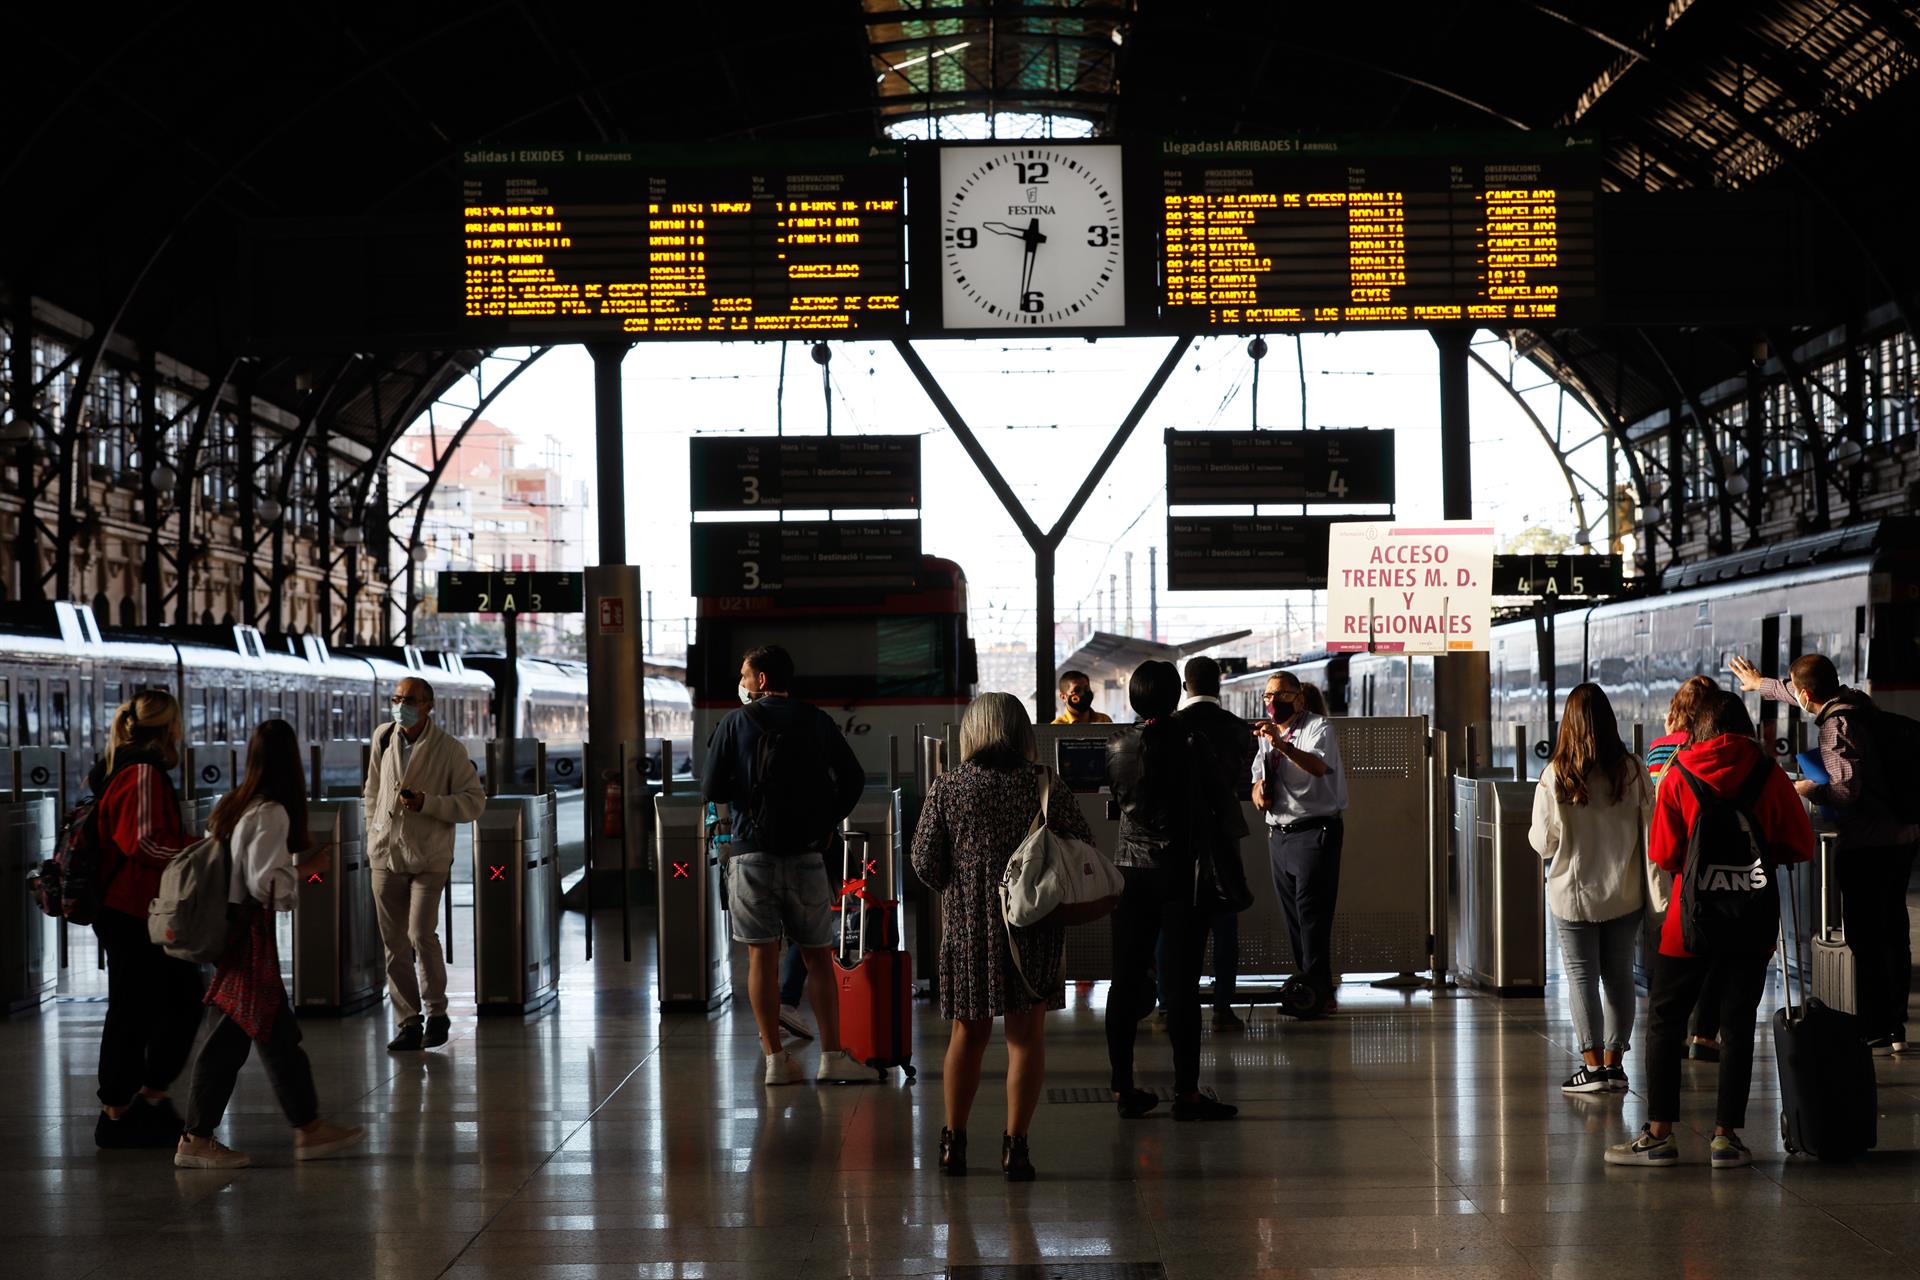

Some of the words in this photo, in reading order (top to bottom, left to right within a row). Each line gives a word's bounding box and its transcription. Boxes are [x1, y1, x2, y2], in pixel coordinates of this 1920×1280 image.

[464, 151, 508, 162] Salidas
[519, 149, 565, 162] EIXIDES
[1163, 140, 1221, 155] Llegadas
[1226, 138, 1291, 152] ARRIBADES
[1013, 162, 1049, 184] 12
[1008, 205, 1056, 216] FESTINA
[957, 227, 978, 249] 9
[1087, 225, 1109, 247] 3
[1024, 292, 1044, 313] 6
[742, 476, 760, 504] 3
[1327, 470, 1348, 498] 4
[1370, 545, 1449, 564] ACCESO
[742, 561, 760, 590] 3
[1342, 568, 1417, 587] TRENES
[1424, 568, 1448, 587] M.
[1456, 568, 1477, 587] D.
[1517, 576, 1530, 594] 4
[1545, 576, 1558, 594] A
[1573, 576, 1584, 594] 5
[478, 593, 489, 611] 2
[503, 593, 517, 611] A
[531, 594, 542, 611] 3
[1402, 592, 1414, 610] Y
[1344, 615, 1472, 634] REGIONALES
[1698, 858, 1768, 892] VANS
